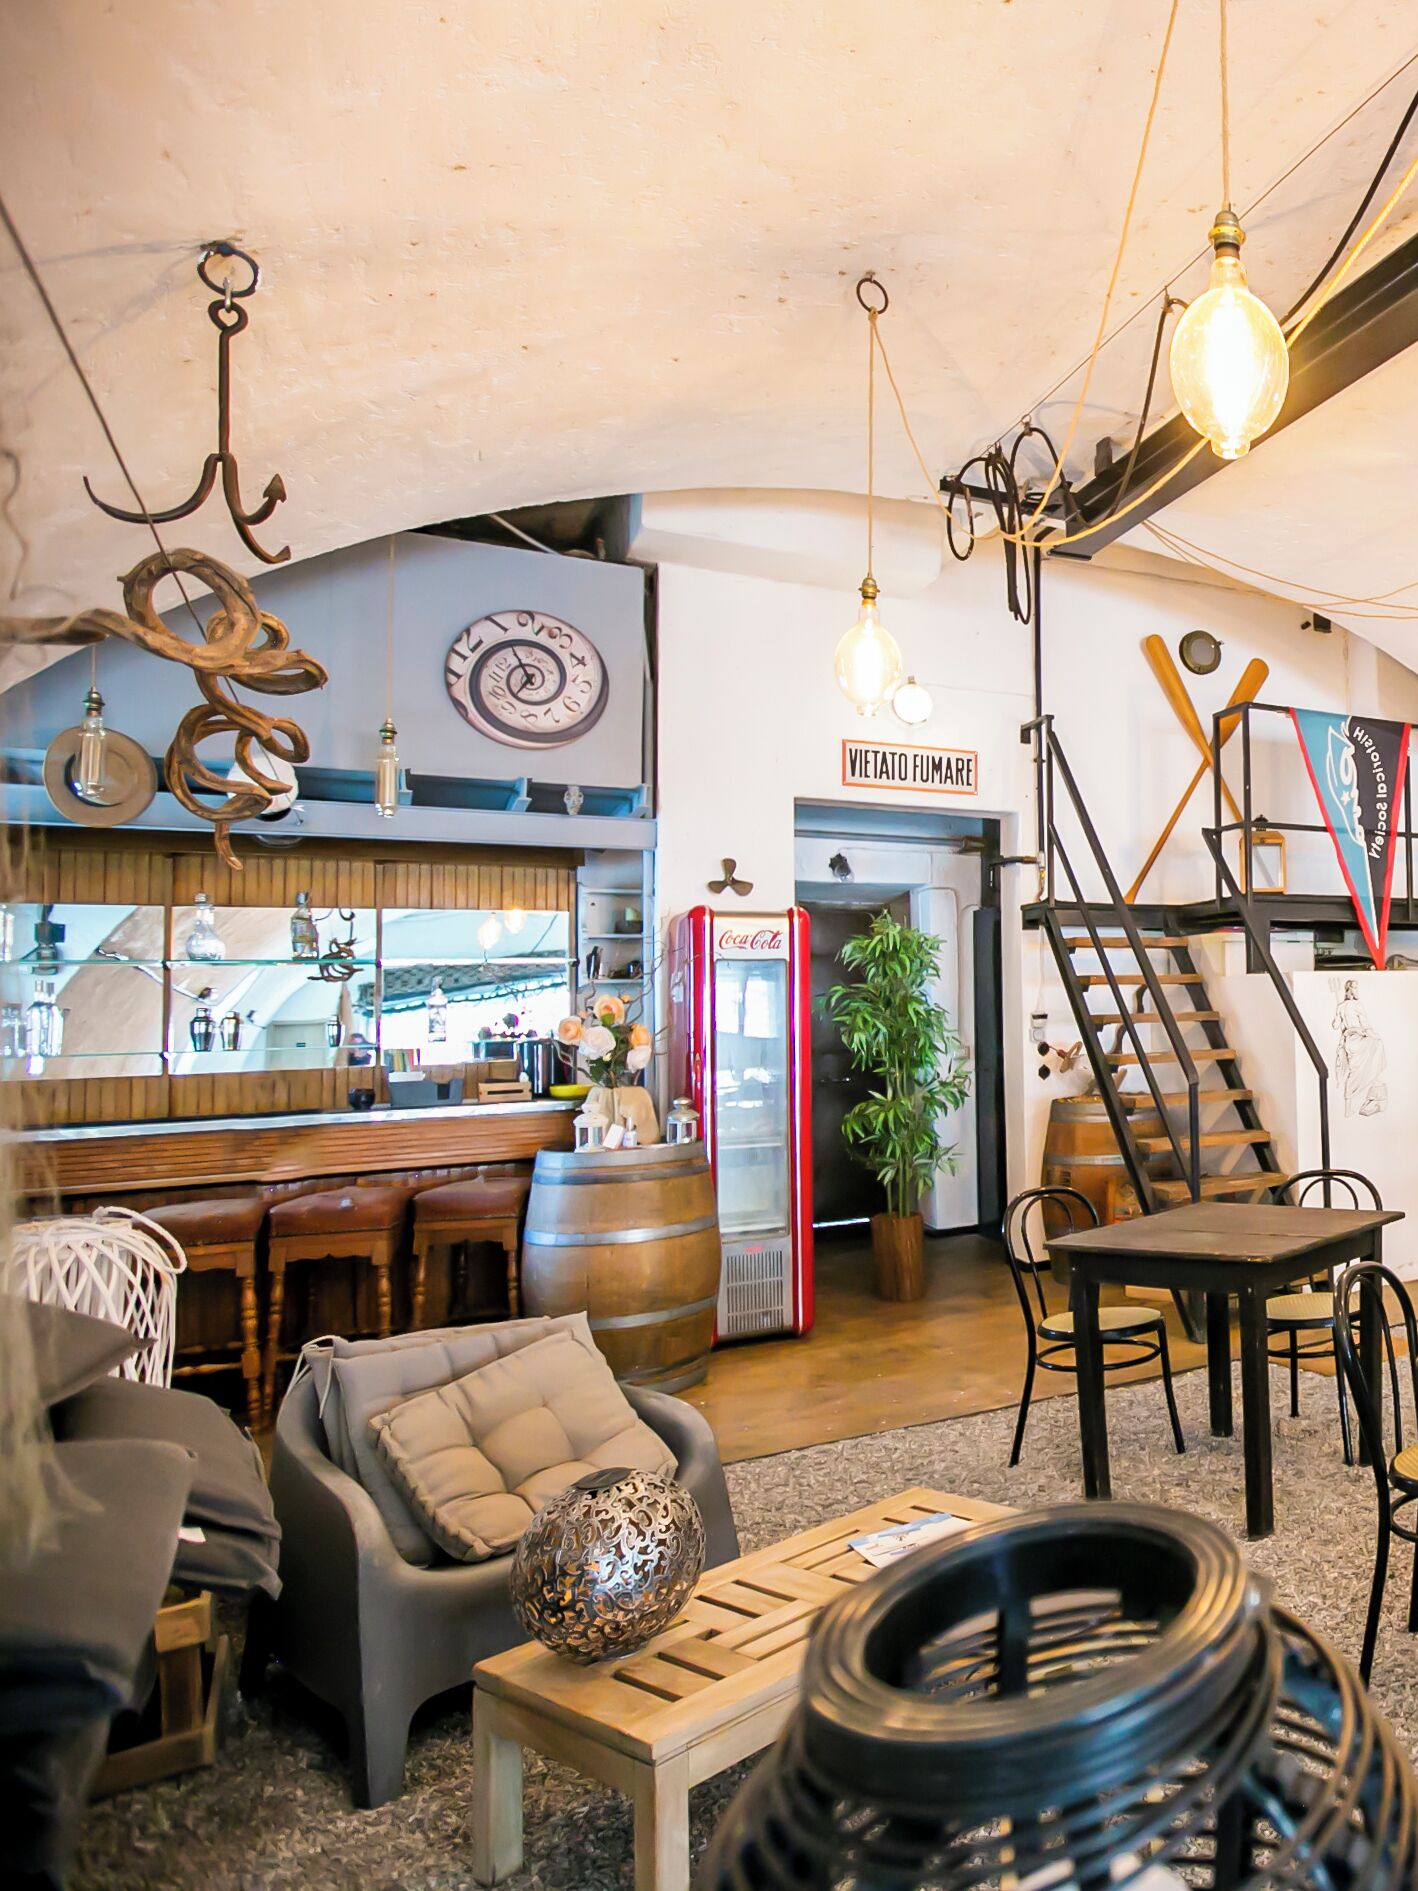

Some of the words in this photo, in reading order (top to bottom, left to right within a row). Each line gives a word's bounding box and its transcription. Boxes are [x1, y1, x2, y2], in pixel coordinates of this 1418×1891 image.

[517, 611, 545, 636] 2
[548, 626, 573, 649] 3
[569, 652, 587, 668] 4
[848, 747, 908, 781] VIETATO
[912, 754, 973, 787] FUMARE
